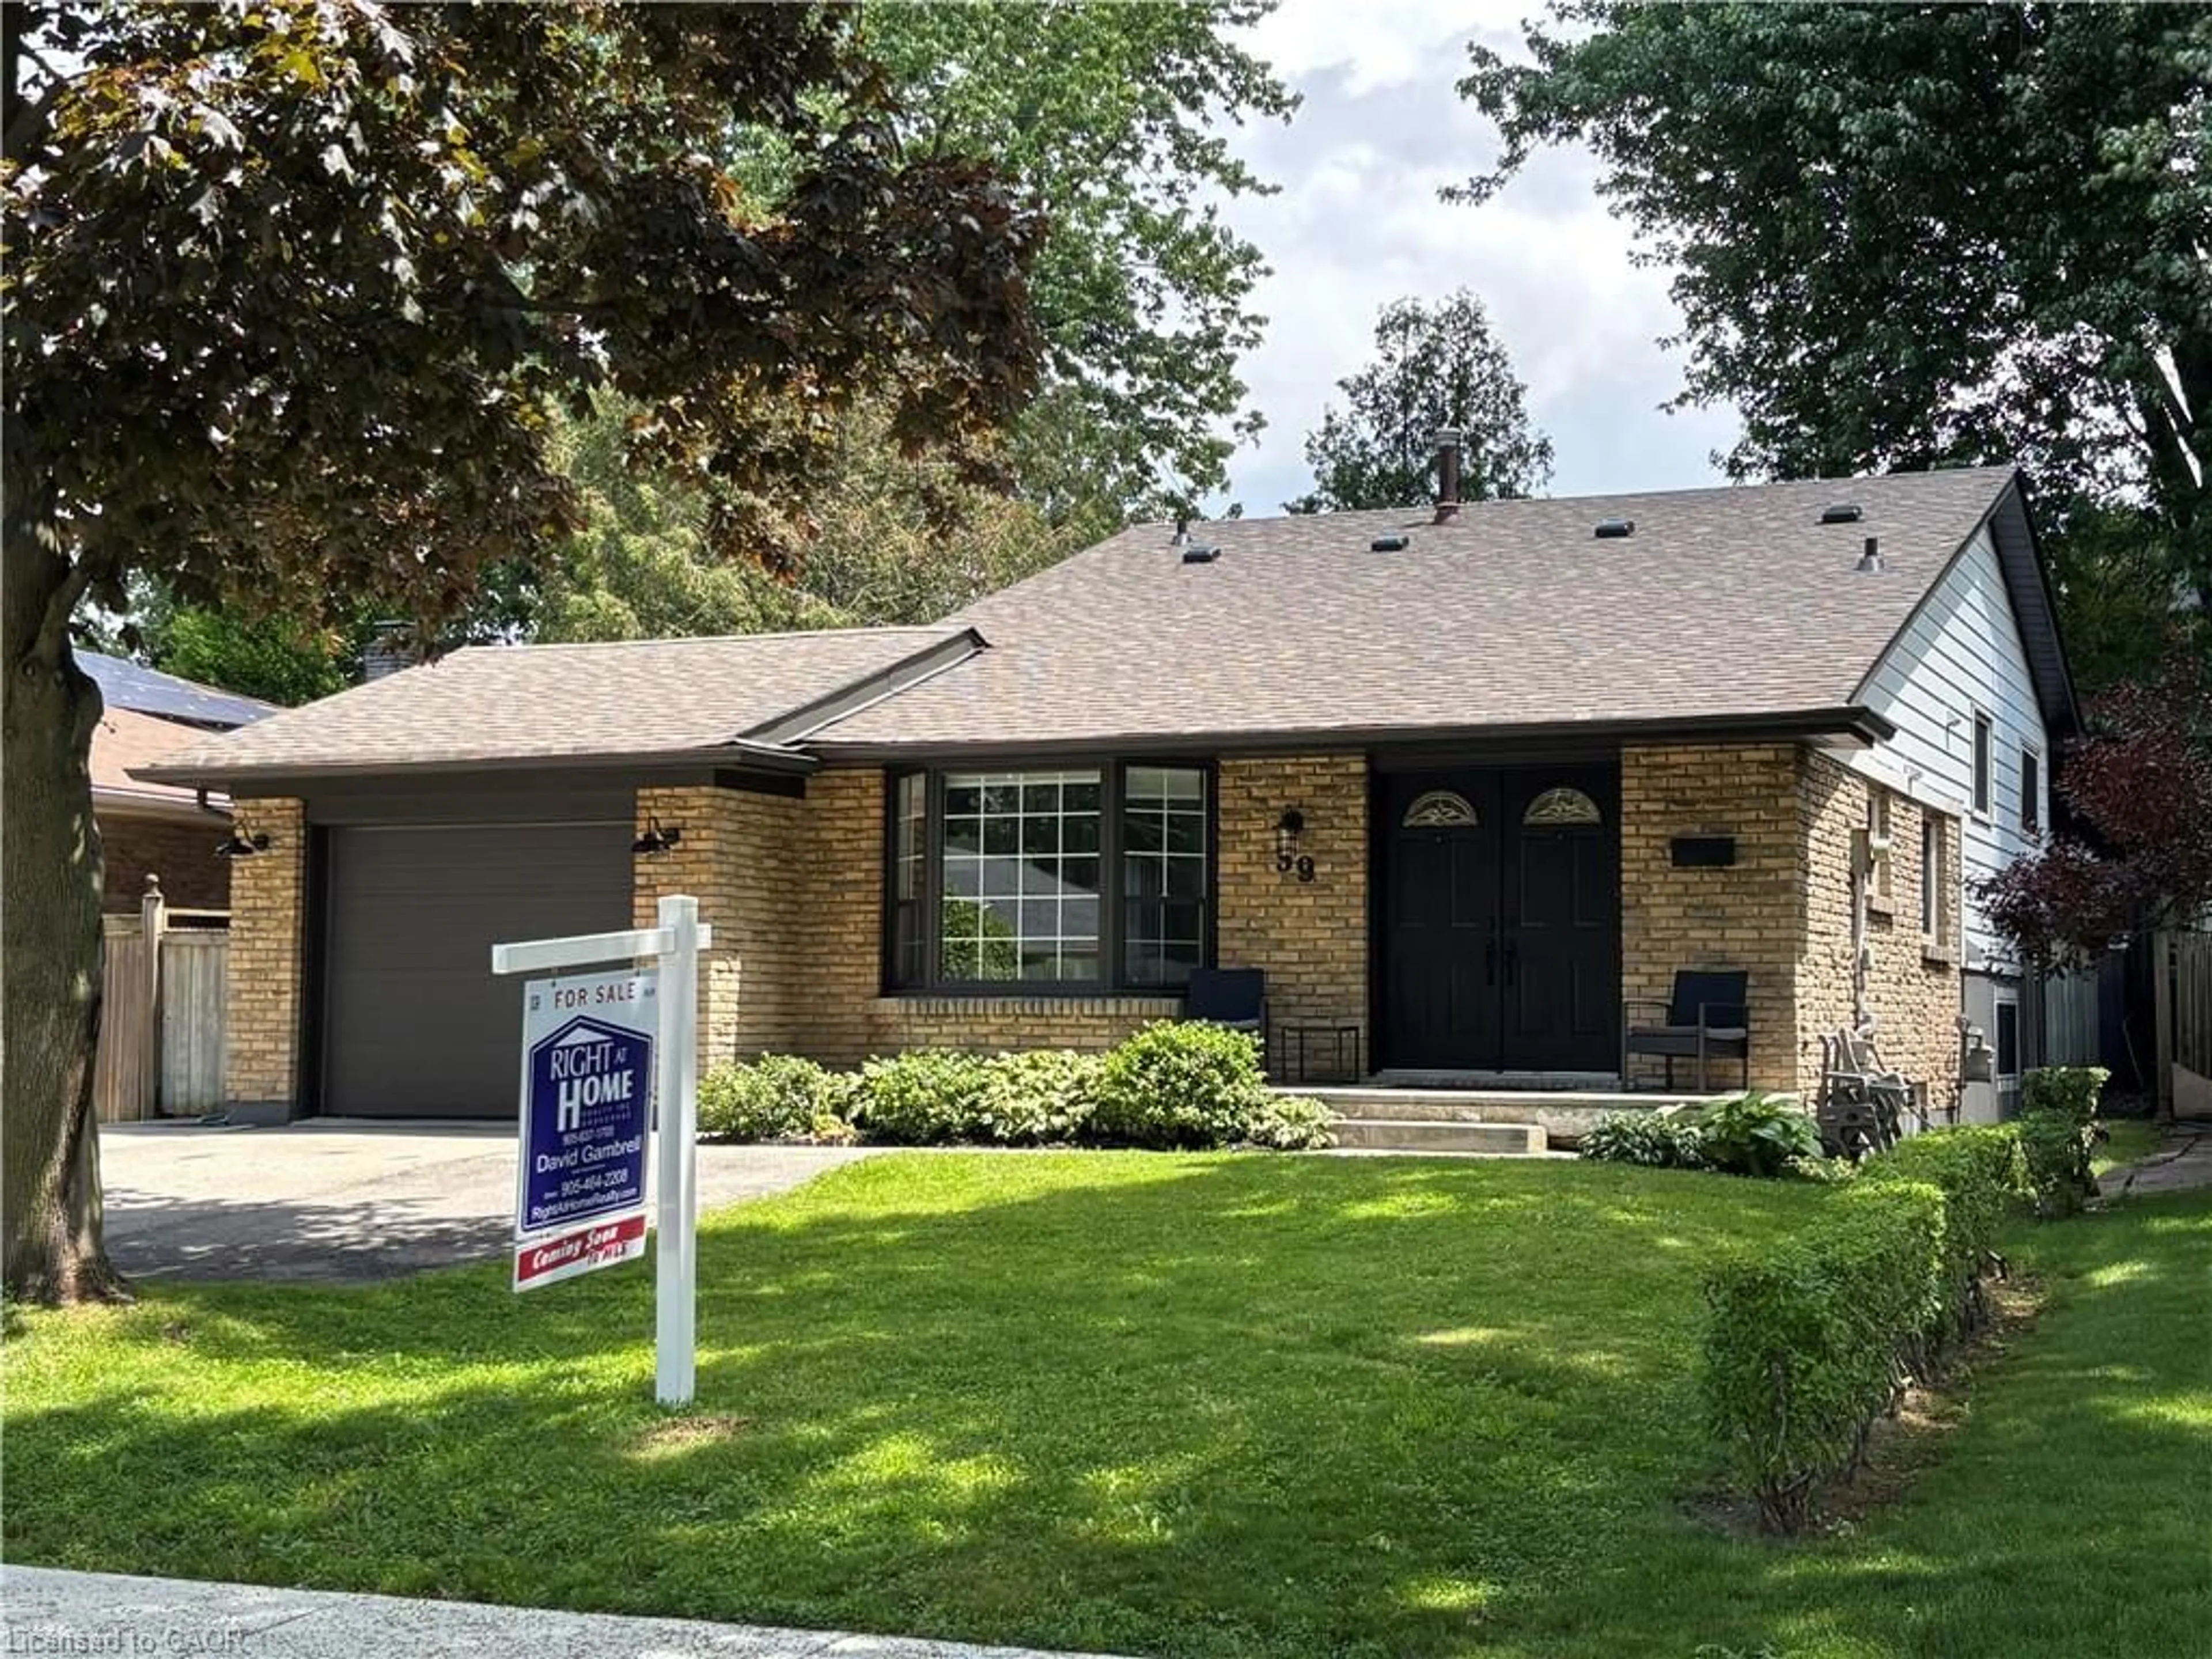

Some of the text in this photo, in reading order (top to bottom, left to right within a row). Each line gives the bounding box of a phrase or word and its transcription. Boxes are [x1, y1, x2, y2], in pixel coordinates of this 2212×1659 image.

[555, 987, 588, 1009] FOR
[596, 982, 635, 1003] SALE
[550, 1041, 628, 1081] RIGHT AT
[557, 1069, 634, 1132] HOME
[537, 1149, 578, 1173] David
[533, 1226, 619, 1270] Coming Soon
